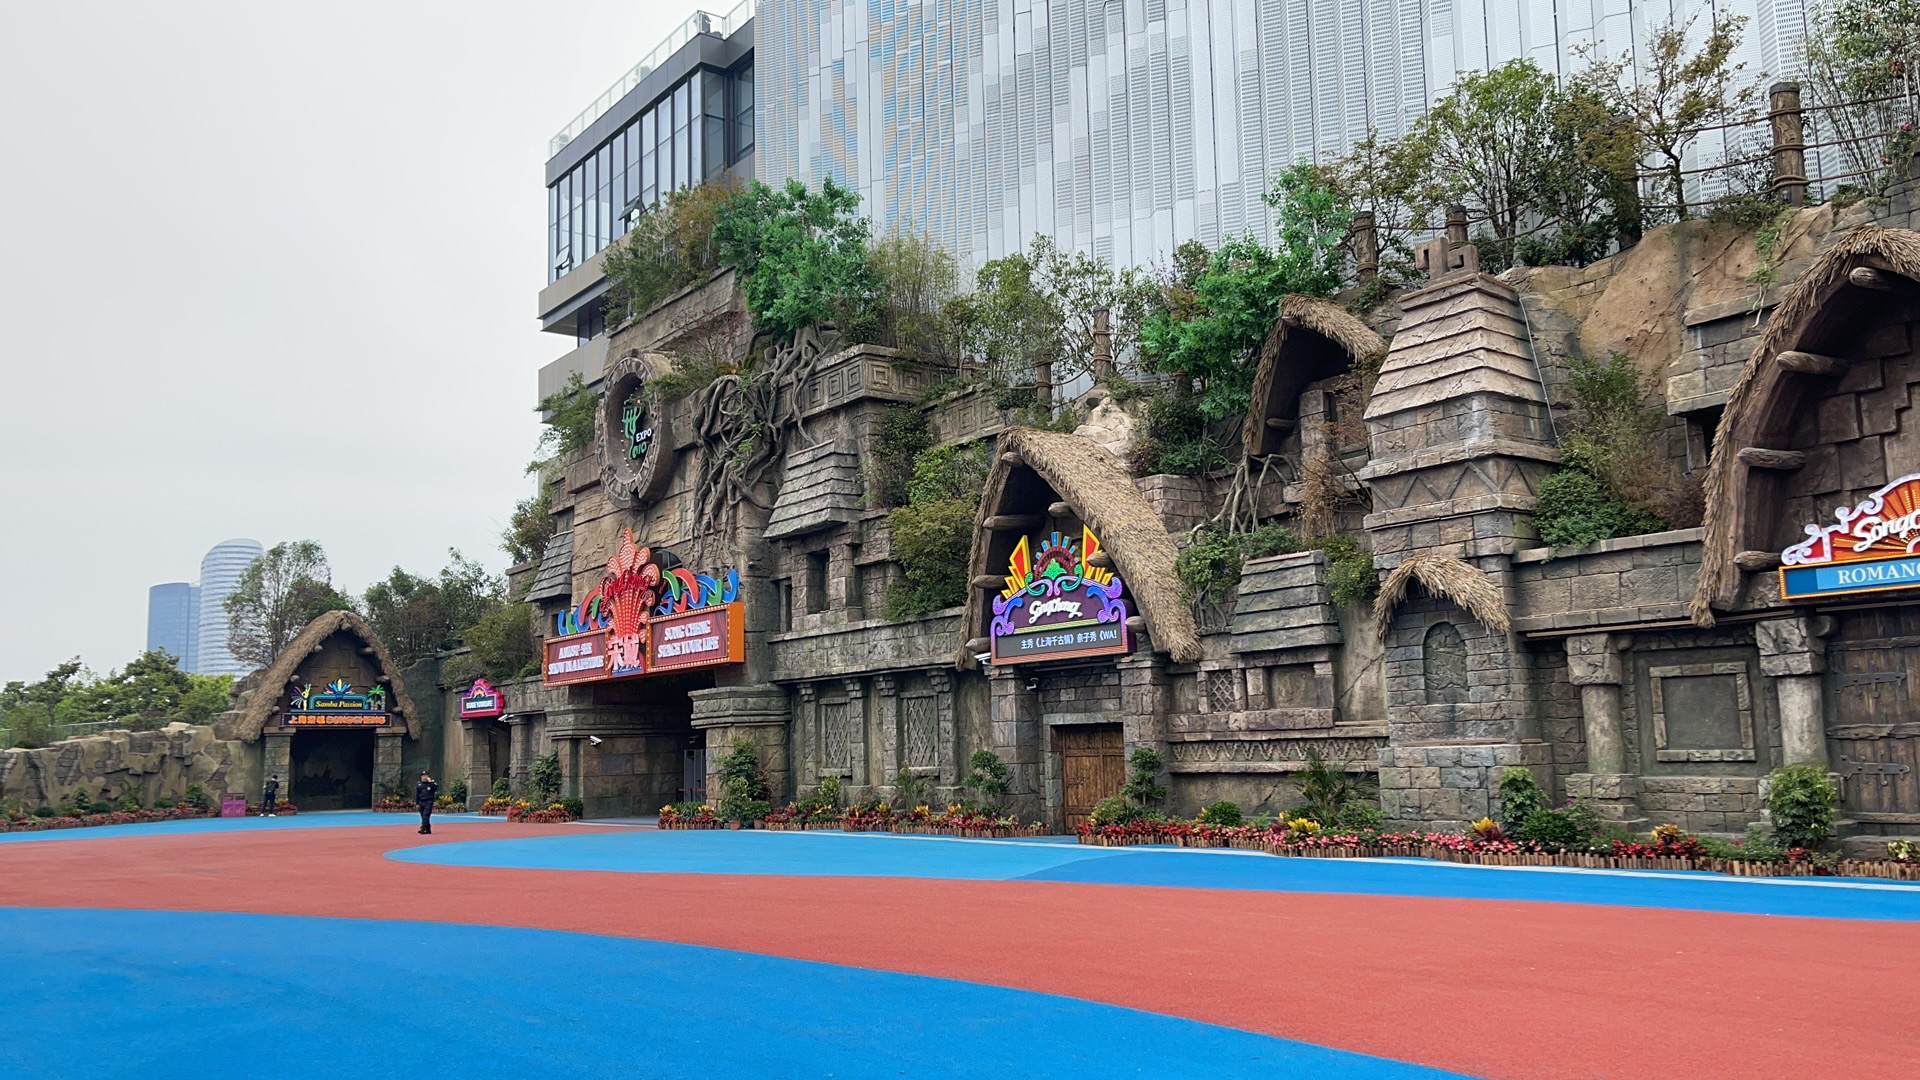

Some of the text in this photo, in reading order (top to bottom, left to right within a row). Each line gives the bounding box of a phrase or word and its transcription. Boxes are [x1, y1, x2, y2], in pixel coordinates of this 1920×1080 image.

[636, 428, 652, 442] EXPO
[1838, 562, 1920, 585] ROMAN
[664, 620, 711, 641] SONG CHENG
[702, 636, 719, 651] LIFE
